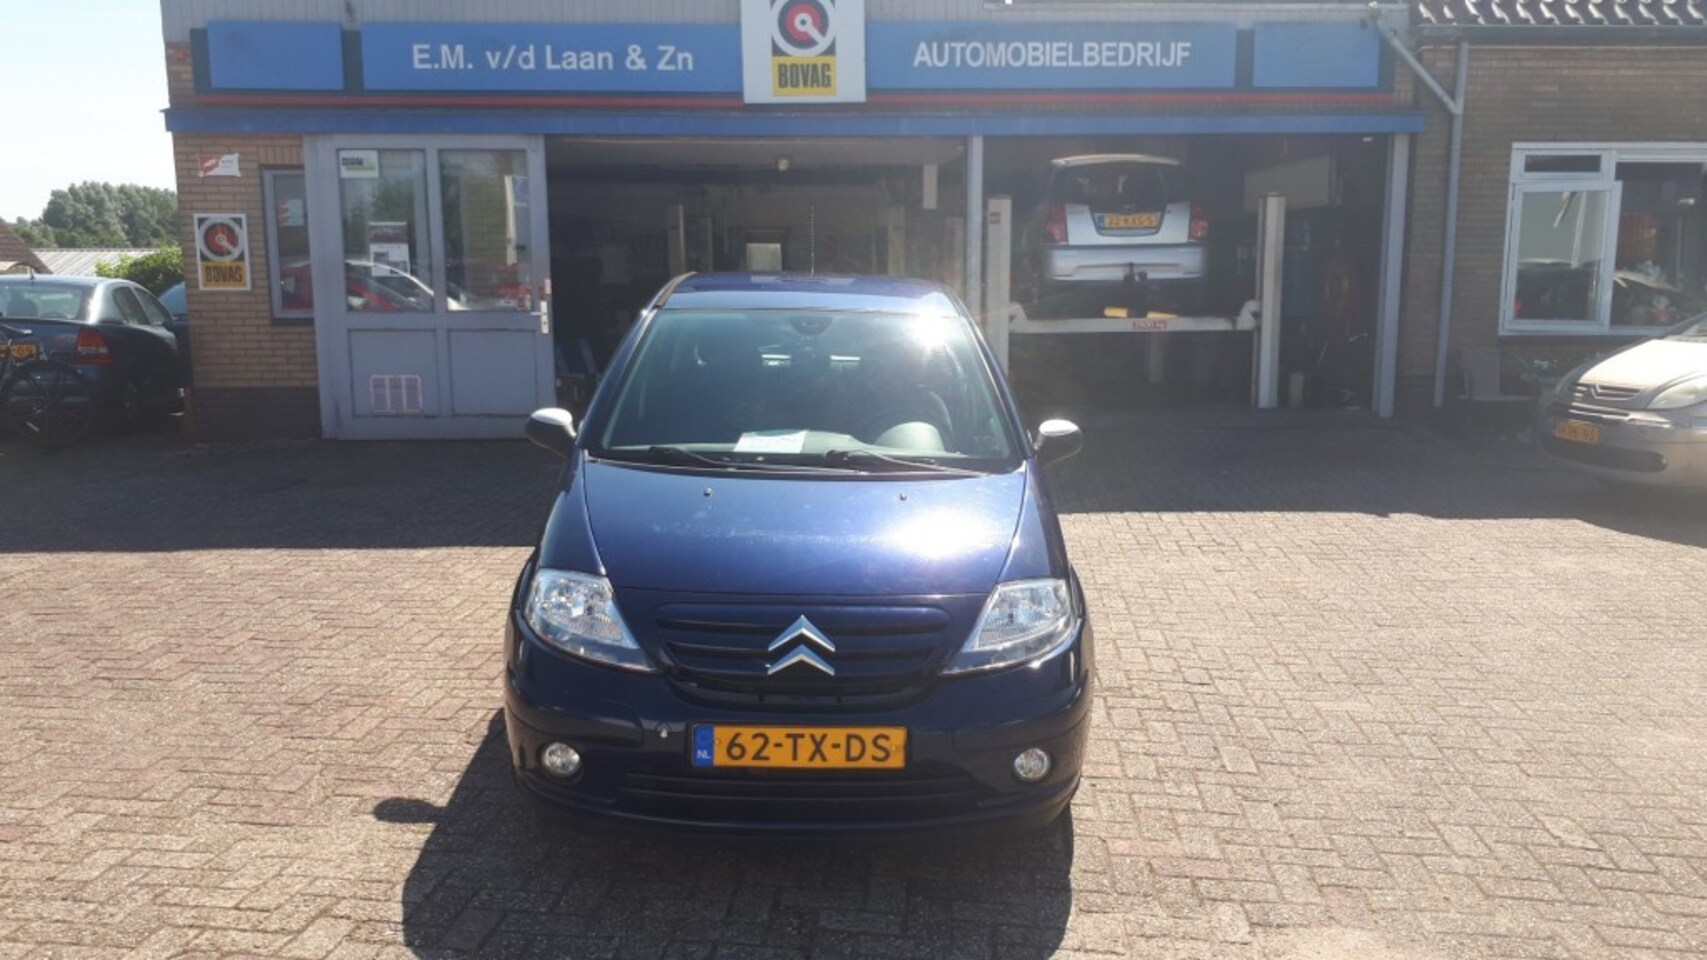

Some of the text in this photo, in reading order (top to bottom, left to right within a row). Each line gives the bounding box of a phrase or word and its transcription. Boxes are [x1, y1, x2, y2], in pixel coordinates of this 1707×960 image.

[413, 43, 694, 71] E.M. v/d Laan & Zn
[913, 41, 1192, 68] AUTOMOBIELBEDRIJF
[777, 63, 831, 88] BOVAG
[204, 265, 243, 283] BOVAG
[696, 749, 711, 760] NL
[726, 732, 891, 763] 62-TX-DS
